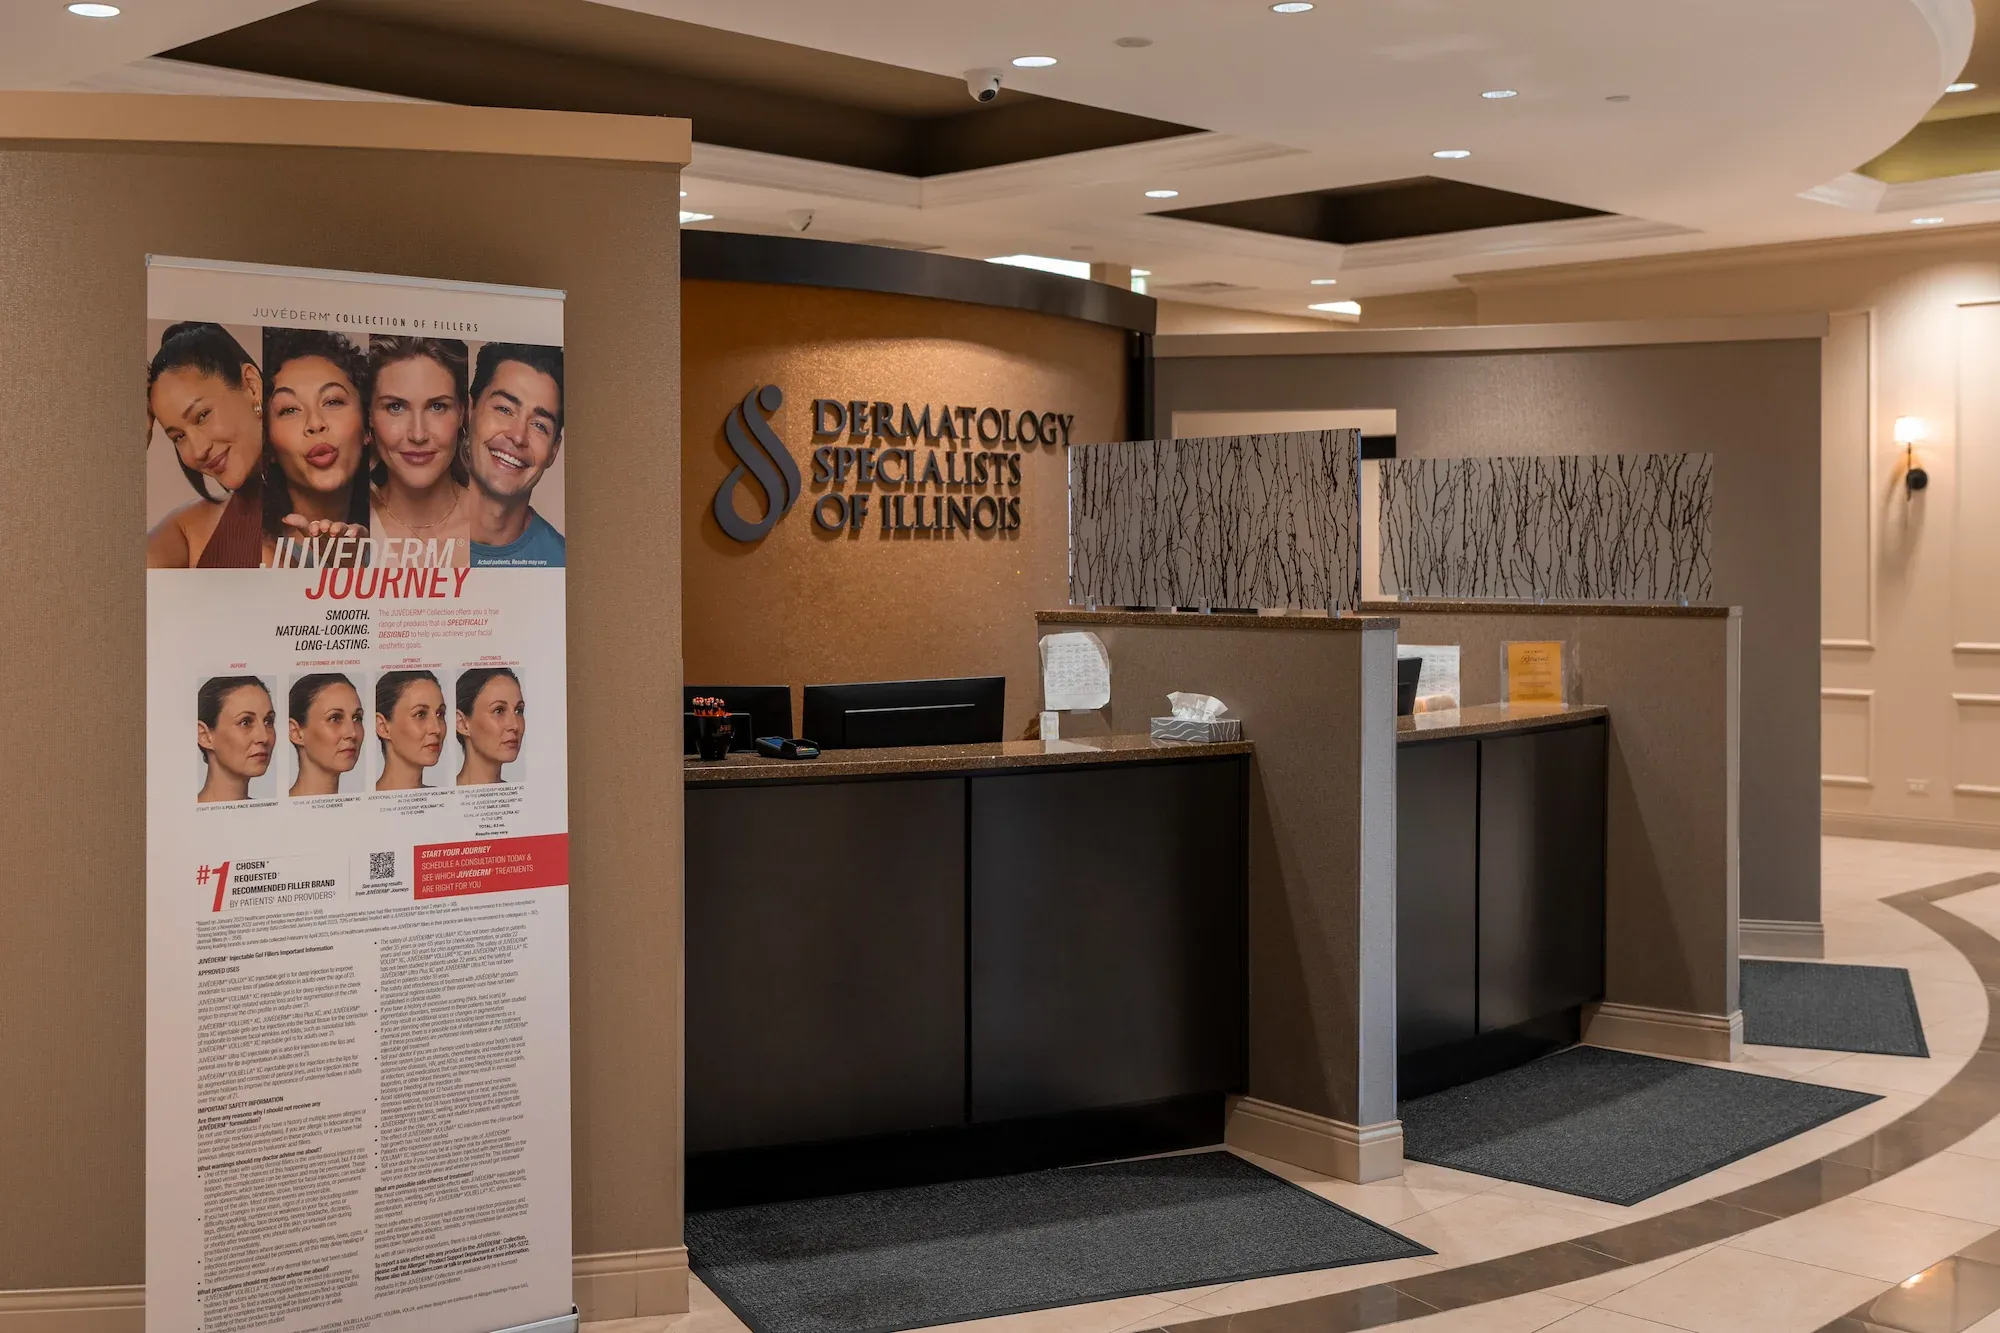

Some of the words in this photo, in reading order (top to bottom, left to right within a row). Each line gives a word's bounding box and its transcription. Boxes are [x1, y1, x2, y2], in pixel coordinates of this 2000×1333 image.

[336, 314, 406, 327] COLLECTION
[414, 320, 425, 328] OF
[434, 321, 478, 332] FILLERS
[814, 400, 1074, 445] DERMATOLOGY
[814, 446, 1021, 487] SPECIALISTS
[815, 493, 868, 531] OF
[881, 495, 1021, 531] ILLINOIS
[305, 567, 470, 599] JOURNEY
[326, 610, 369, 620] SMOOTH.
[276, 624, 370, 636] NATURAL-LOOKING.
[295, 639, 370, 650] LONG-LASTING.
[406, 642, 421, 650] goals.
[461, 846, 491, 855] JOURNEY
[422, 861, 454, 870] SCHEDULE
[461, 856, 506, 866] CONSULTATION
[508, 854, 525, 862] TODAY
[434, 872, 455, 880] WHICH
[496, 865, 533, 875] TREATMENTS
[196, 861, 230, 912] #1
[232, 884, 286, 895] RECOMMENDED
[288, 881, 310, 890] FILLER
[312, 879, 335, 888] BRAND
[436, 884, 454, 892] RIGHT
[230, 900, 238, 908] BY
[277, 895, 292, 903] AND
[229, 953, 254, 961] Injectable
[280, 948, 304, 956] Important
[305, 945, 333, 953] Information
[198, 968, 225, 976] APPROVED
[198, 1104, 228, 1113] IMPORTANT
[229, 1101, 247, 1109] SAFETY
[248, 1097, 283, 1106] INFORMATION
[230, 1117, 261, 1126] formulation?
[381, 1260, 395, 1268] report
[411, 1254, 425, 1262] effect
[445, 1248, 461, 1256] product
[465, 1249, 490, 1258] Department
